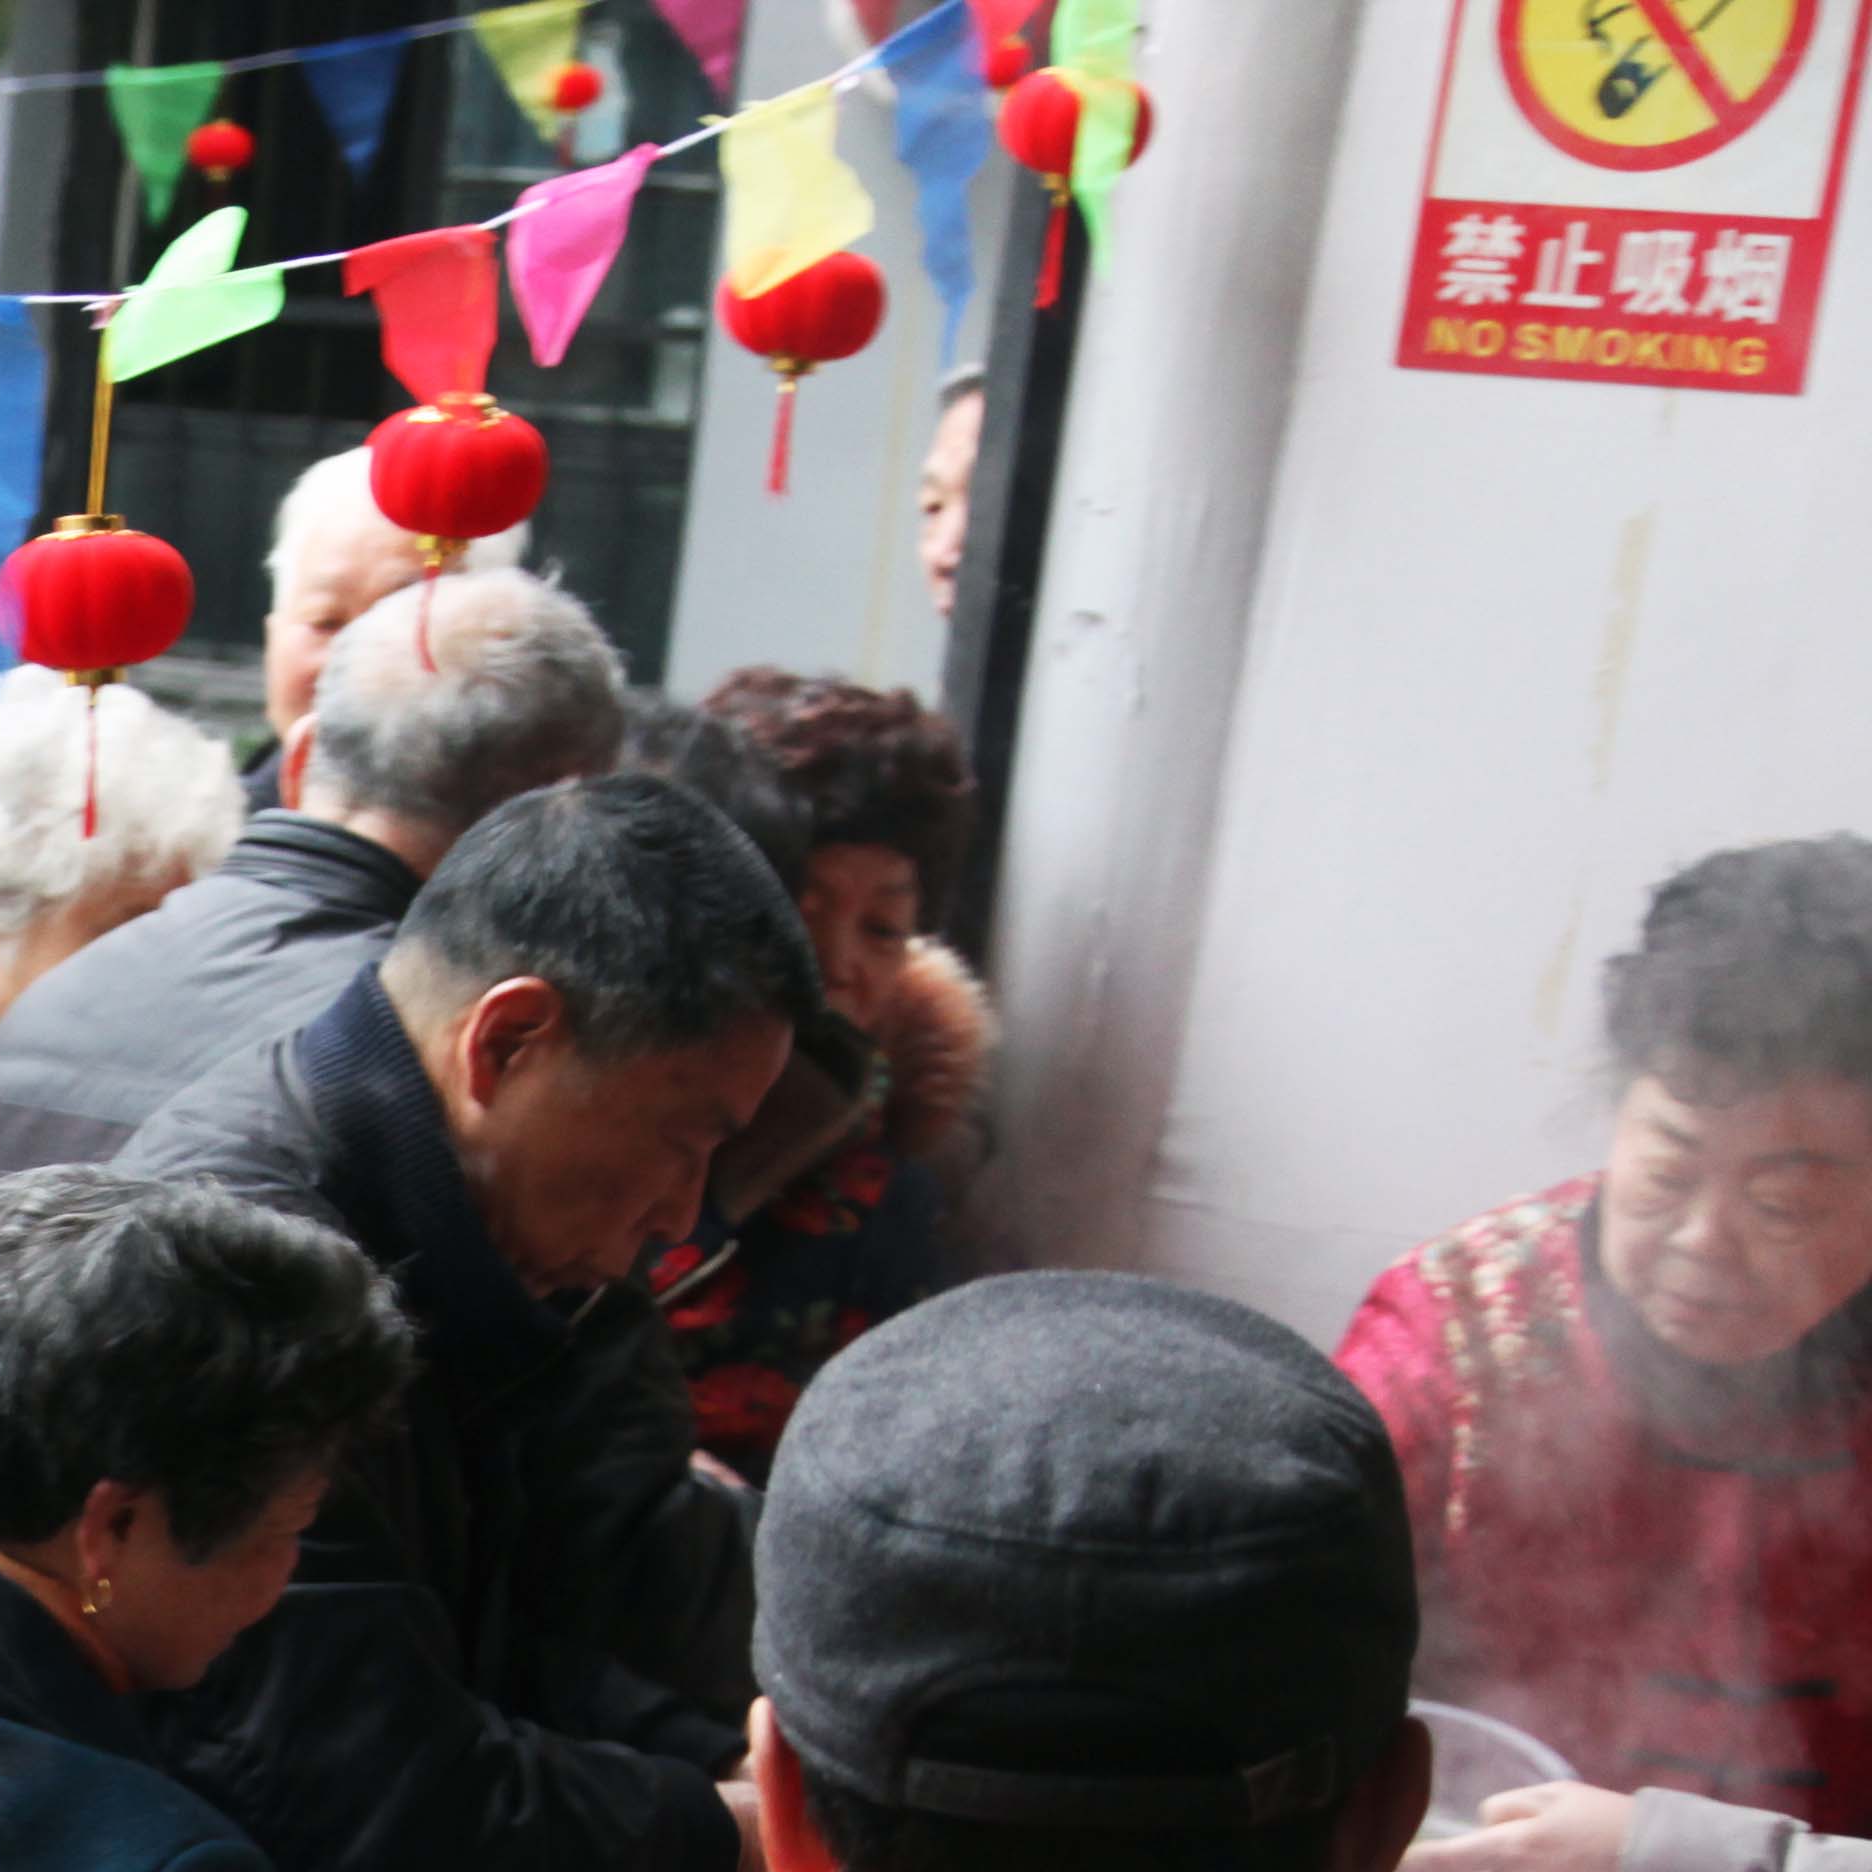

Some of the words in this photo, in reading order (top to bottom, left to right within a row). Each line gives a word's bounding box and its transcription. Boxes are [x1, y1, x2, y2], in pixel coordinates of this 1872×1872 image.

[1434, 212, 1795, 325] 禁止吸烟
[1424, 317, 1505, 358] NO
[1510, 323, 1770, 377] SMOKING
